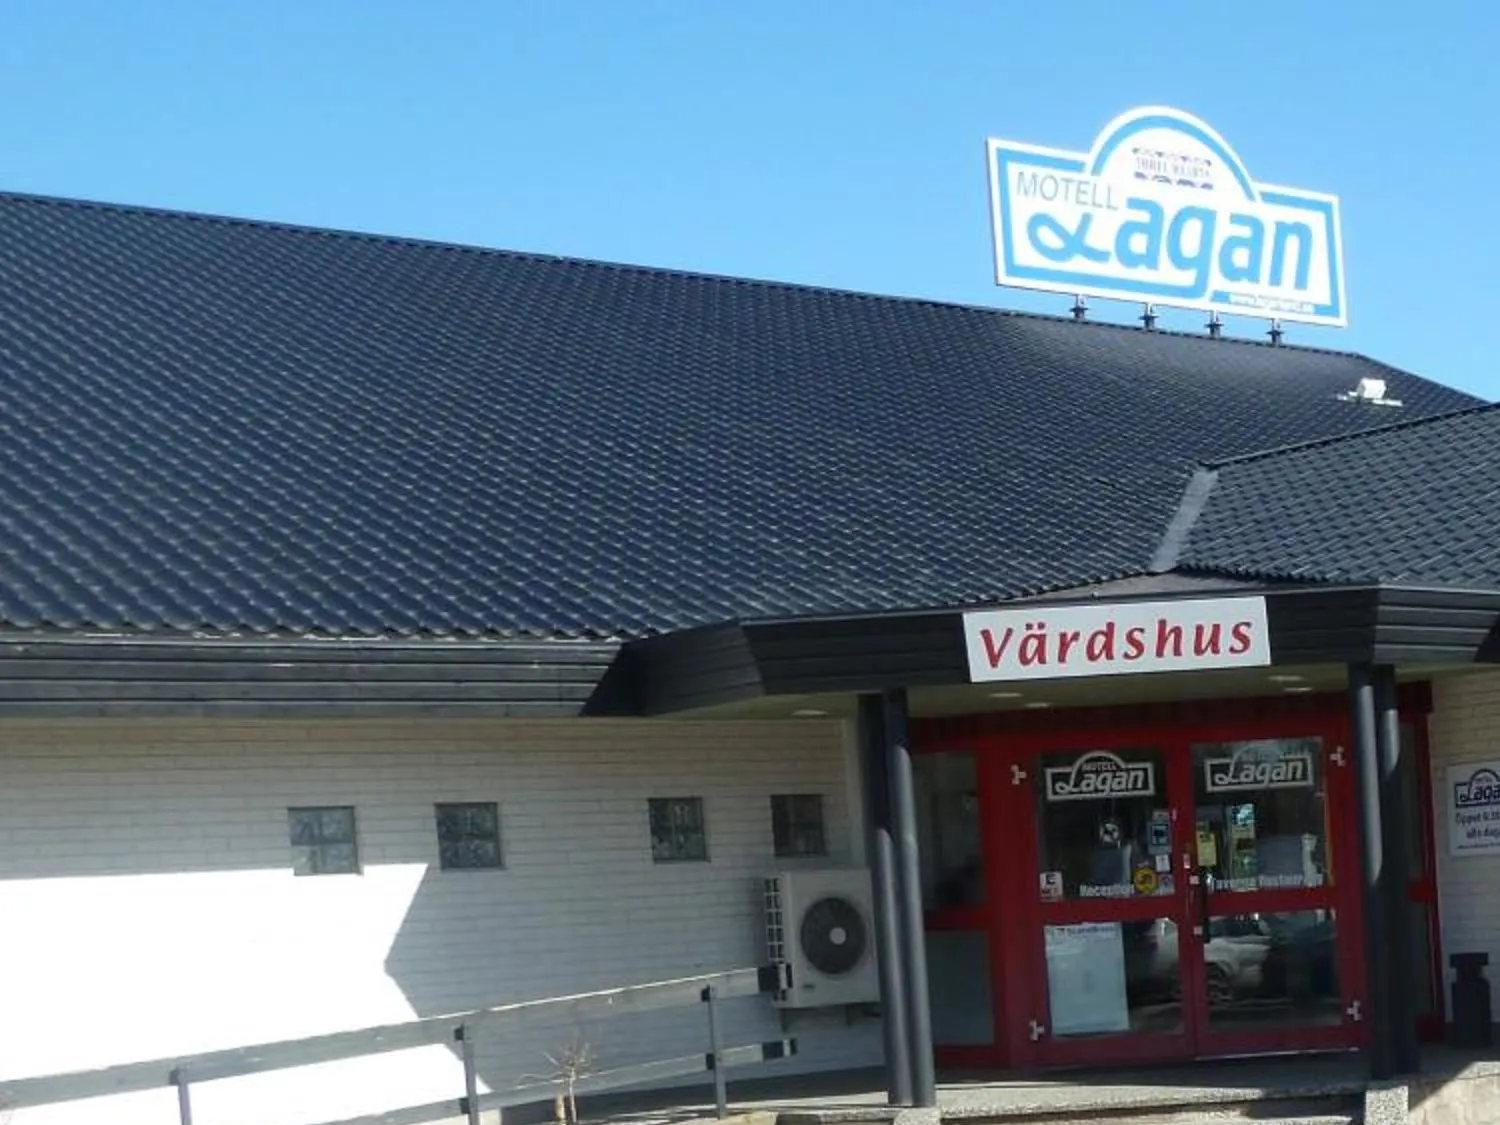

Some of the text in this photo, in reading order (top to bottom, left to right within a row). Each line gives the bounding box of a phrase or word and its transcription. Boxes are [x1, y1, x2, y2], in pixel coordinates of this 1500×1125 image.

[1016, 170, 1120, 212] MOTELL
[1026, 196, 1314, 300] Lagan
[980, 617, 1253, 670] Värdshus
[1055, 768, 1145, 796] Lagan
